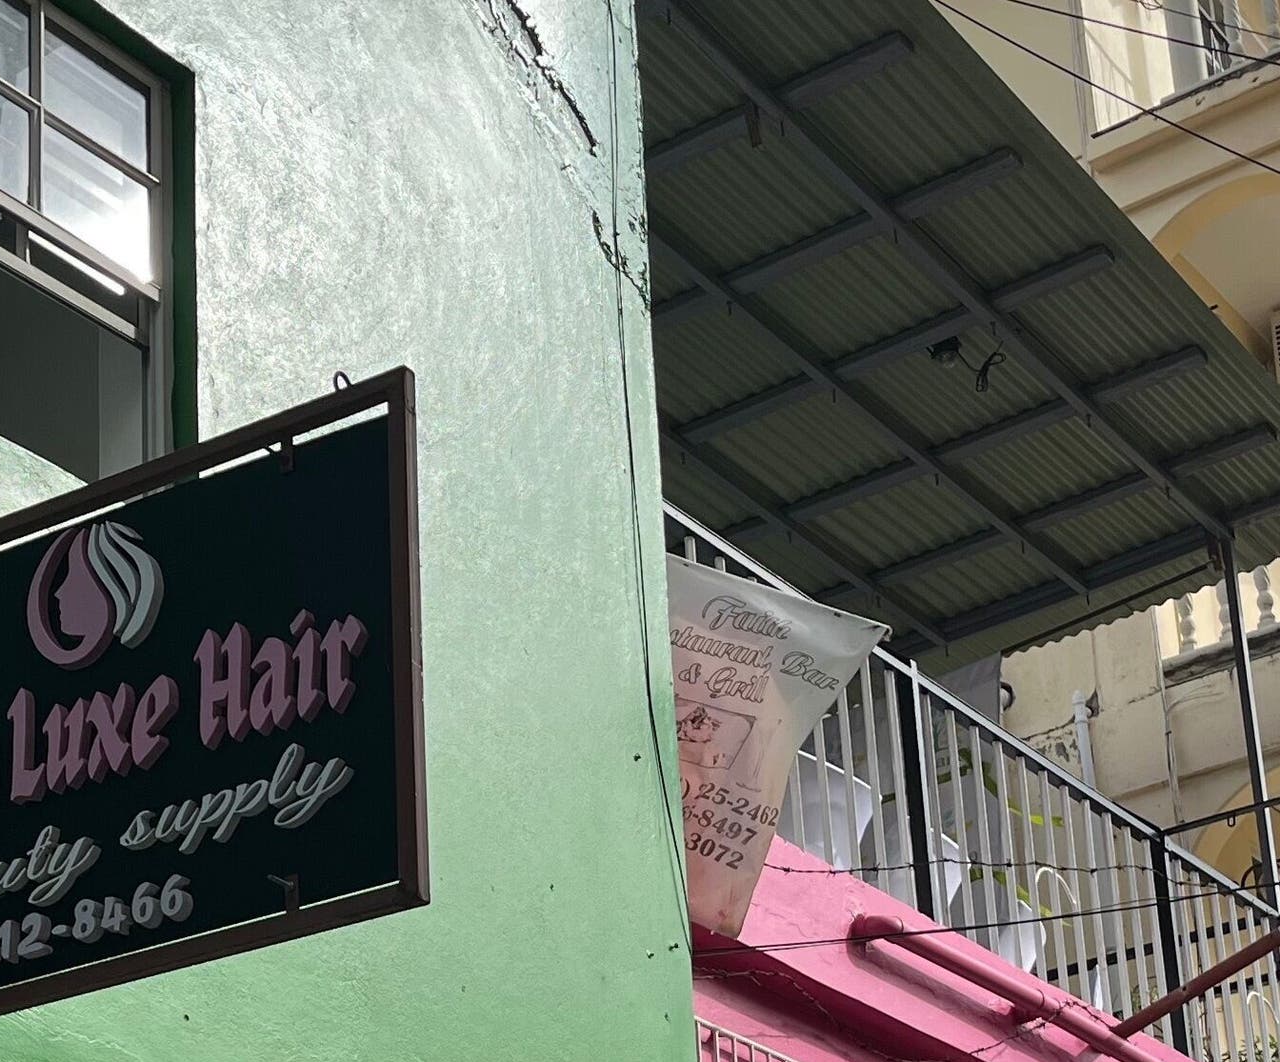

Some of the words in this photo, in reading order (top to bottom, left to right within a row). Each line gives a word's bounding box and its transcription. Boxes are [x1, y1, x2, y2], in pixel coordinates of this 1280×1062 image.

[7, 687, 180, 802] Luxe
[193, 608, 369, 751] Hair
[705, 666, 769, 703] Grill
[120, 743, 355, 855] supply
